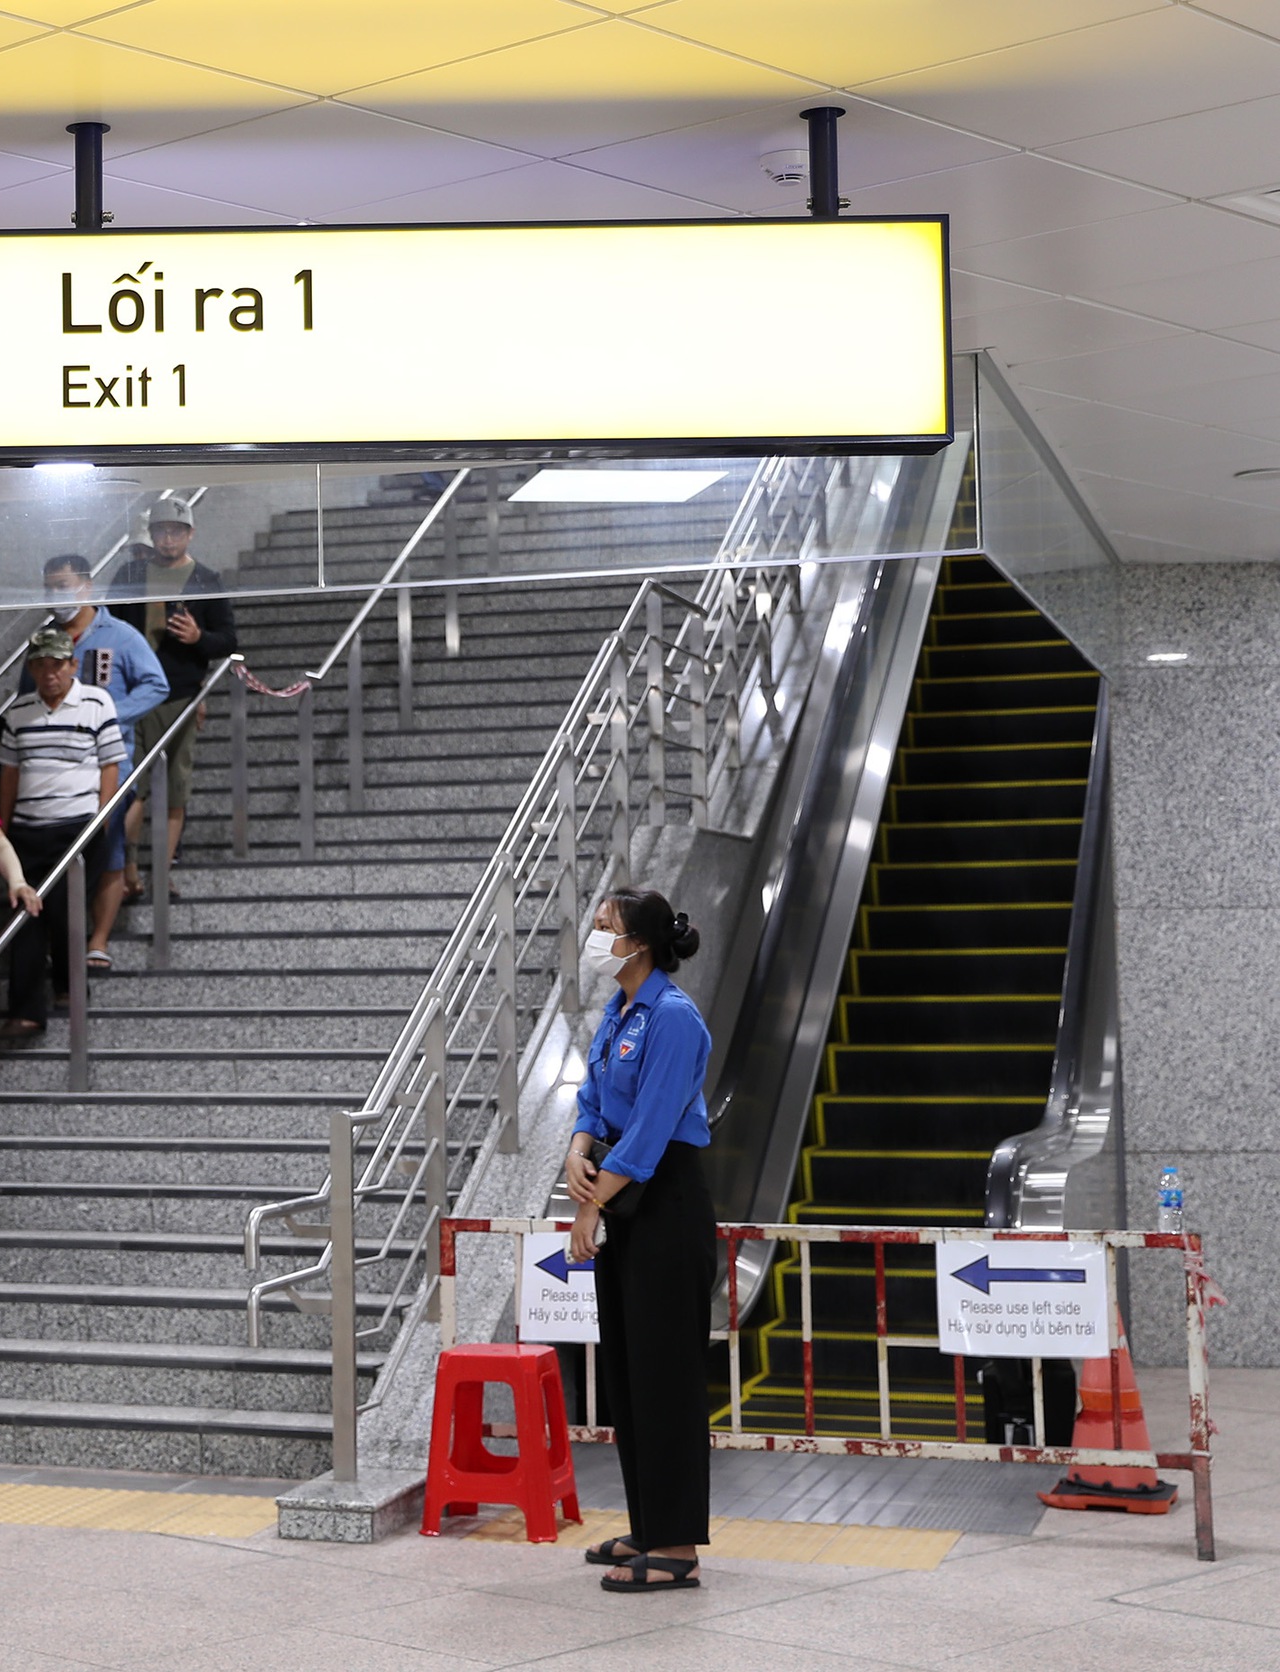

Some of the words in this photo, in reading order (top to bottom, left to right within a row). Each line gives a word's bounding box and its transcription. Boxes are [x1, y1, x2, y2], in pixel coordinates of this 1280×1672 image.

[61, 261, 165, 334] Lối
[195, 287, 264, 332] ra
[294, 269, 313, 331] 1
[61, 364, 152, 408] Exit
[172, 364, 186, 407] 1
[541, 1288, 579, 1302] Please
[581, 1291, 597, 1302] us
[960, 1299, 1003, 1314] Please
[1006, 1303, 1029, 1314] use
[1032, 1301, 1052, 1314] left
[1055, 1301, 1081, 1315] side
[995, 1321, 1027, 1338] dụng
[1049, 1321, 1072, 1335] bên
